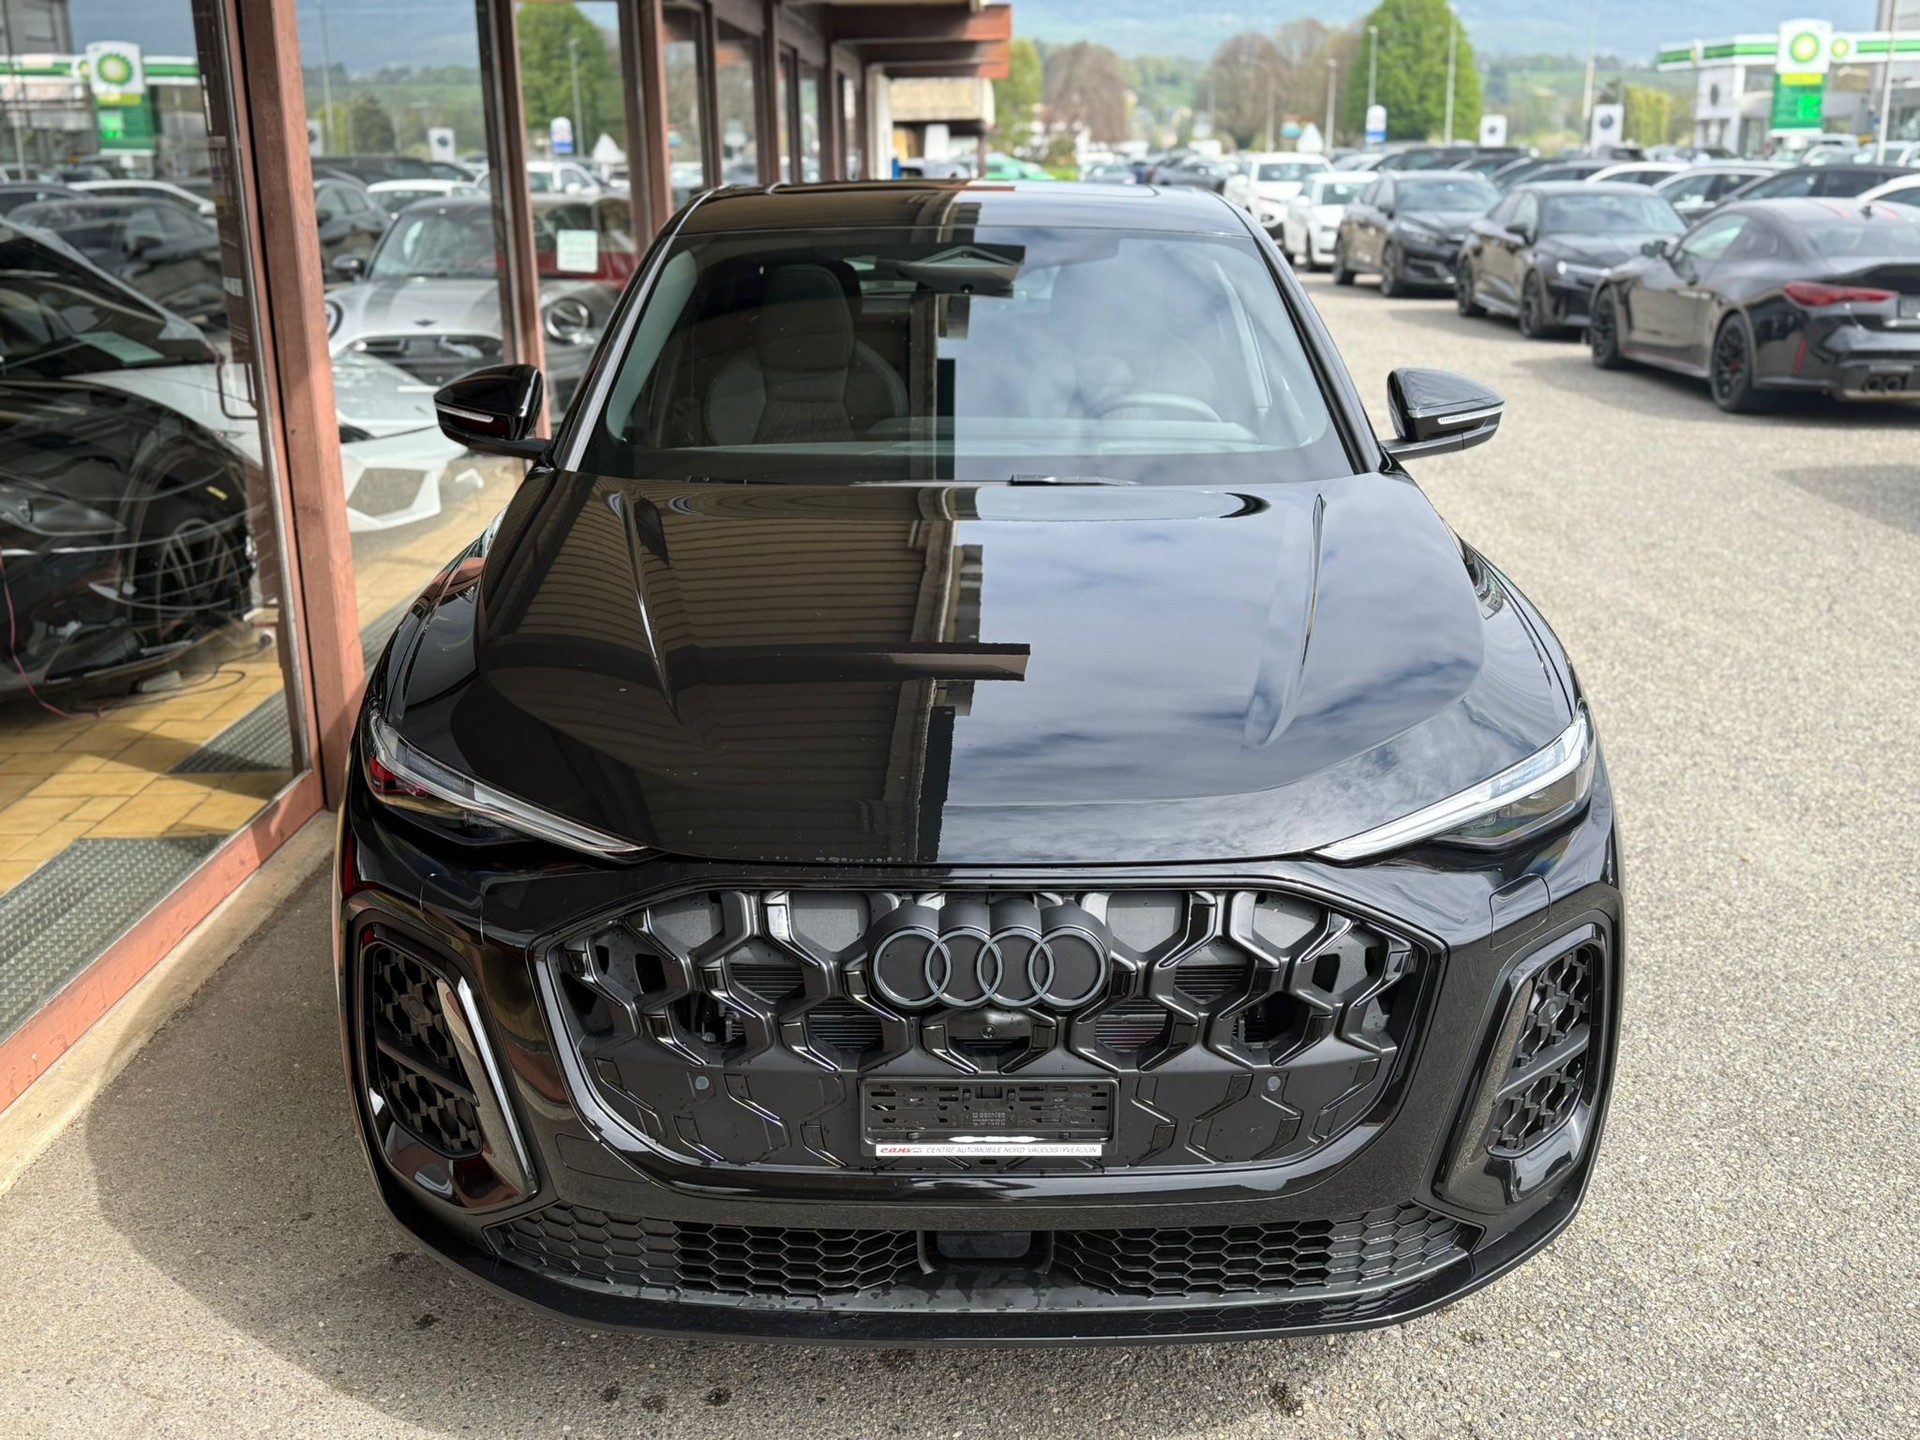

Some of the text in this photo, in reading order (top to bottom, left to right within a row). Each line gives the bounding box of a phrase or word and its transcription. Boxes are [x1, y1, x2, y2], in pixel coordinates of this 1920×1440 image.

[926, 1146, 956, 1154] CENTRE
[956, 1146, 1002, 1154] AUTOMOBILE
[1003, 1146, 1025, 1154] NORD
